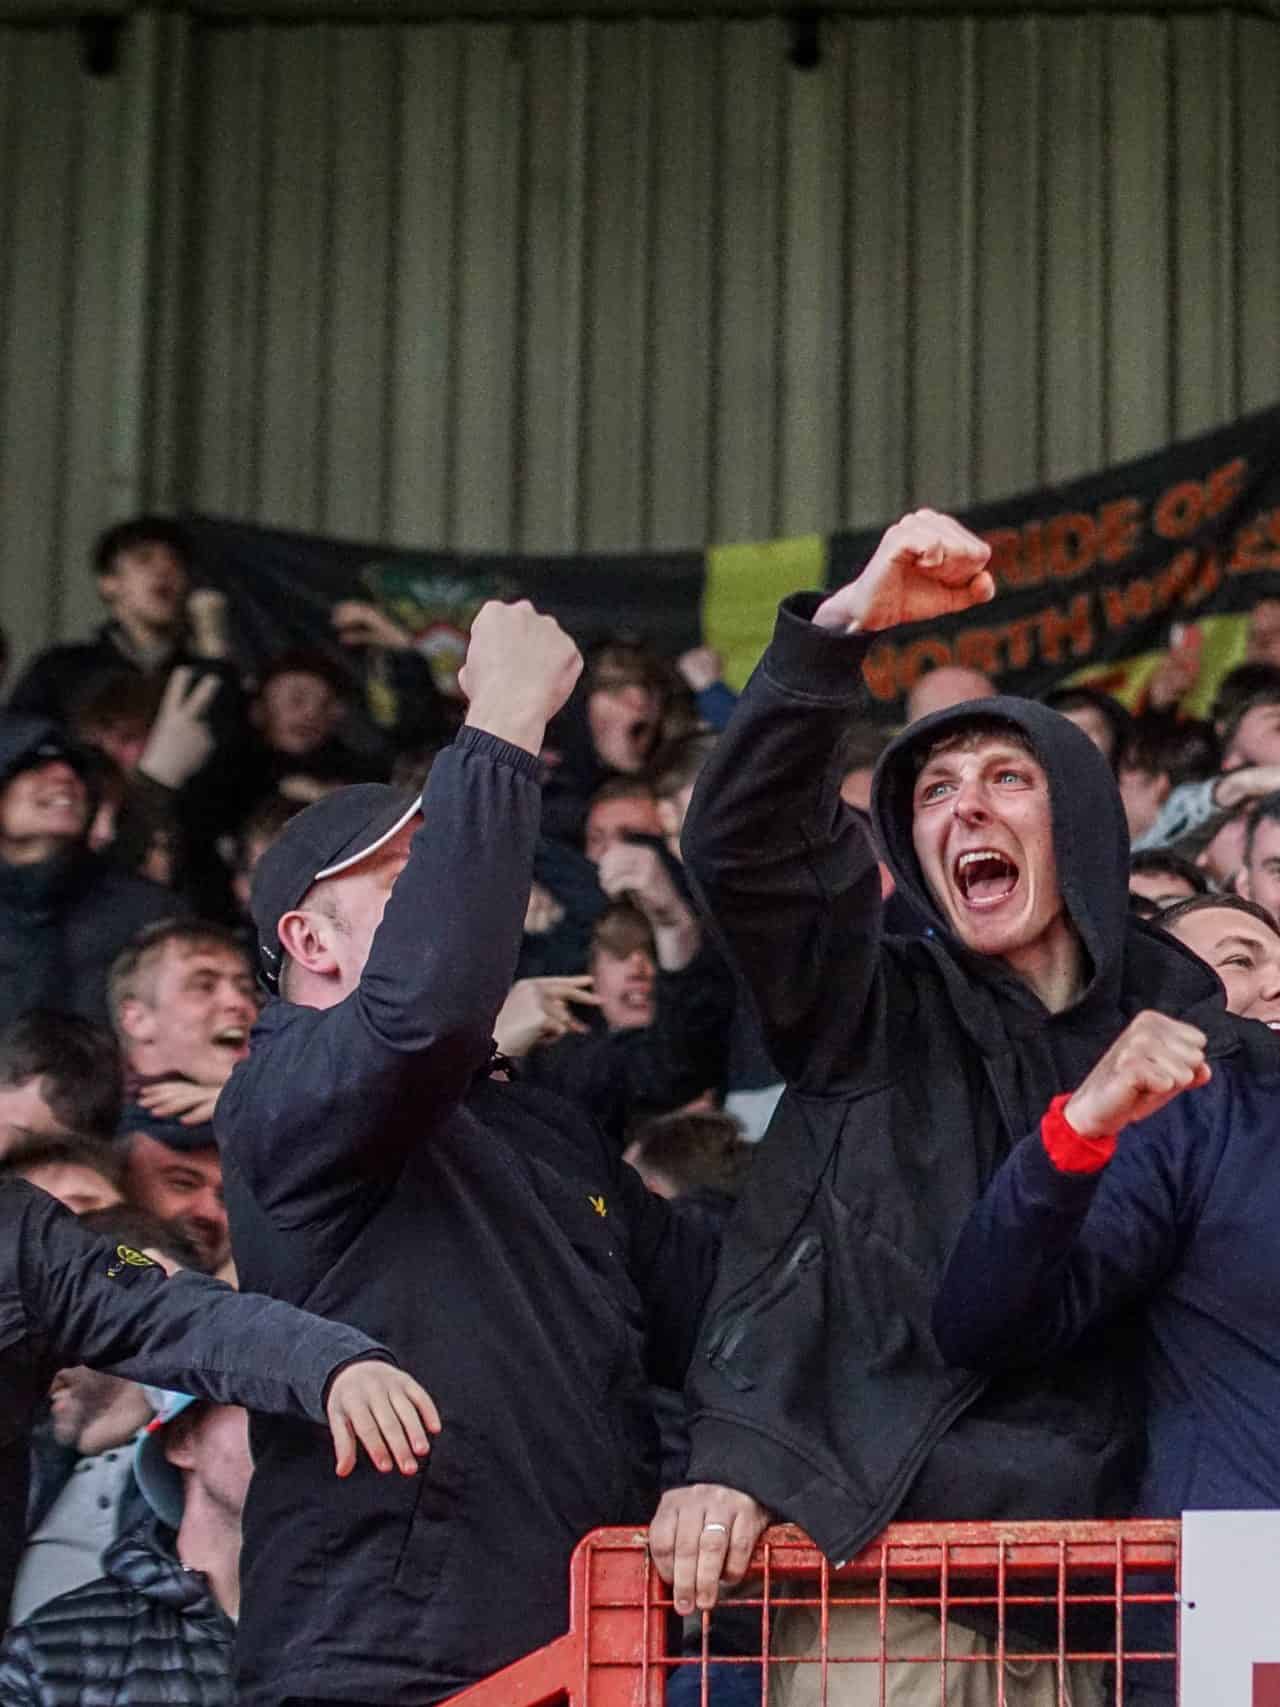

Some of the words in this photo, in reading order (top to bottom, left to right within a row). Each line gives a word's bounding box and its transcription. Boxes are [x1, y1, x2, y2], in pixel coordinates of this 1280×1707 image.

[986, 500, 1141, 588] RIDE
[1155, 458, 1247, 540] OF
[862, 594, 1094, 701] NORTH
